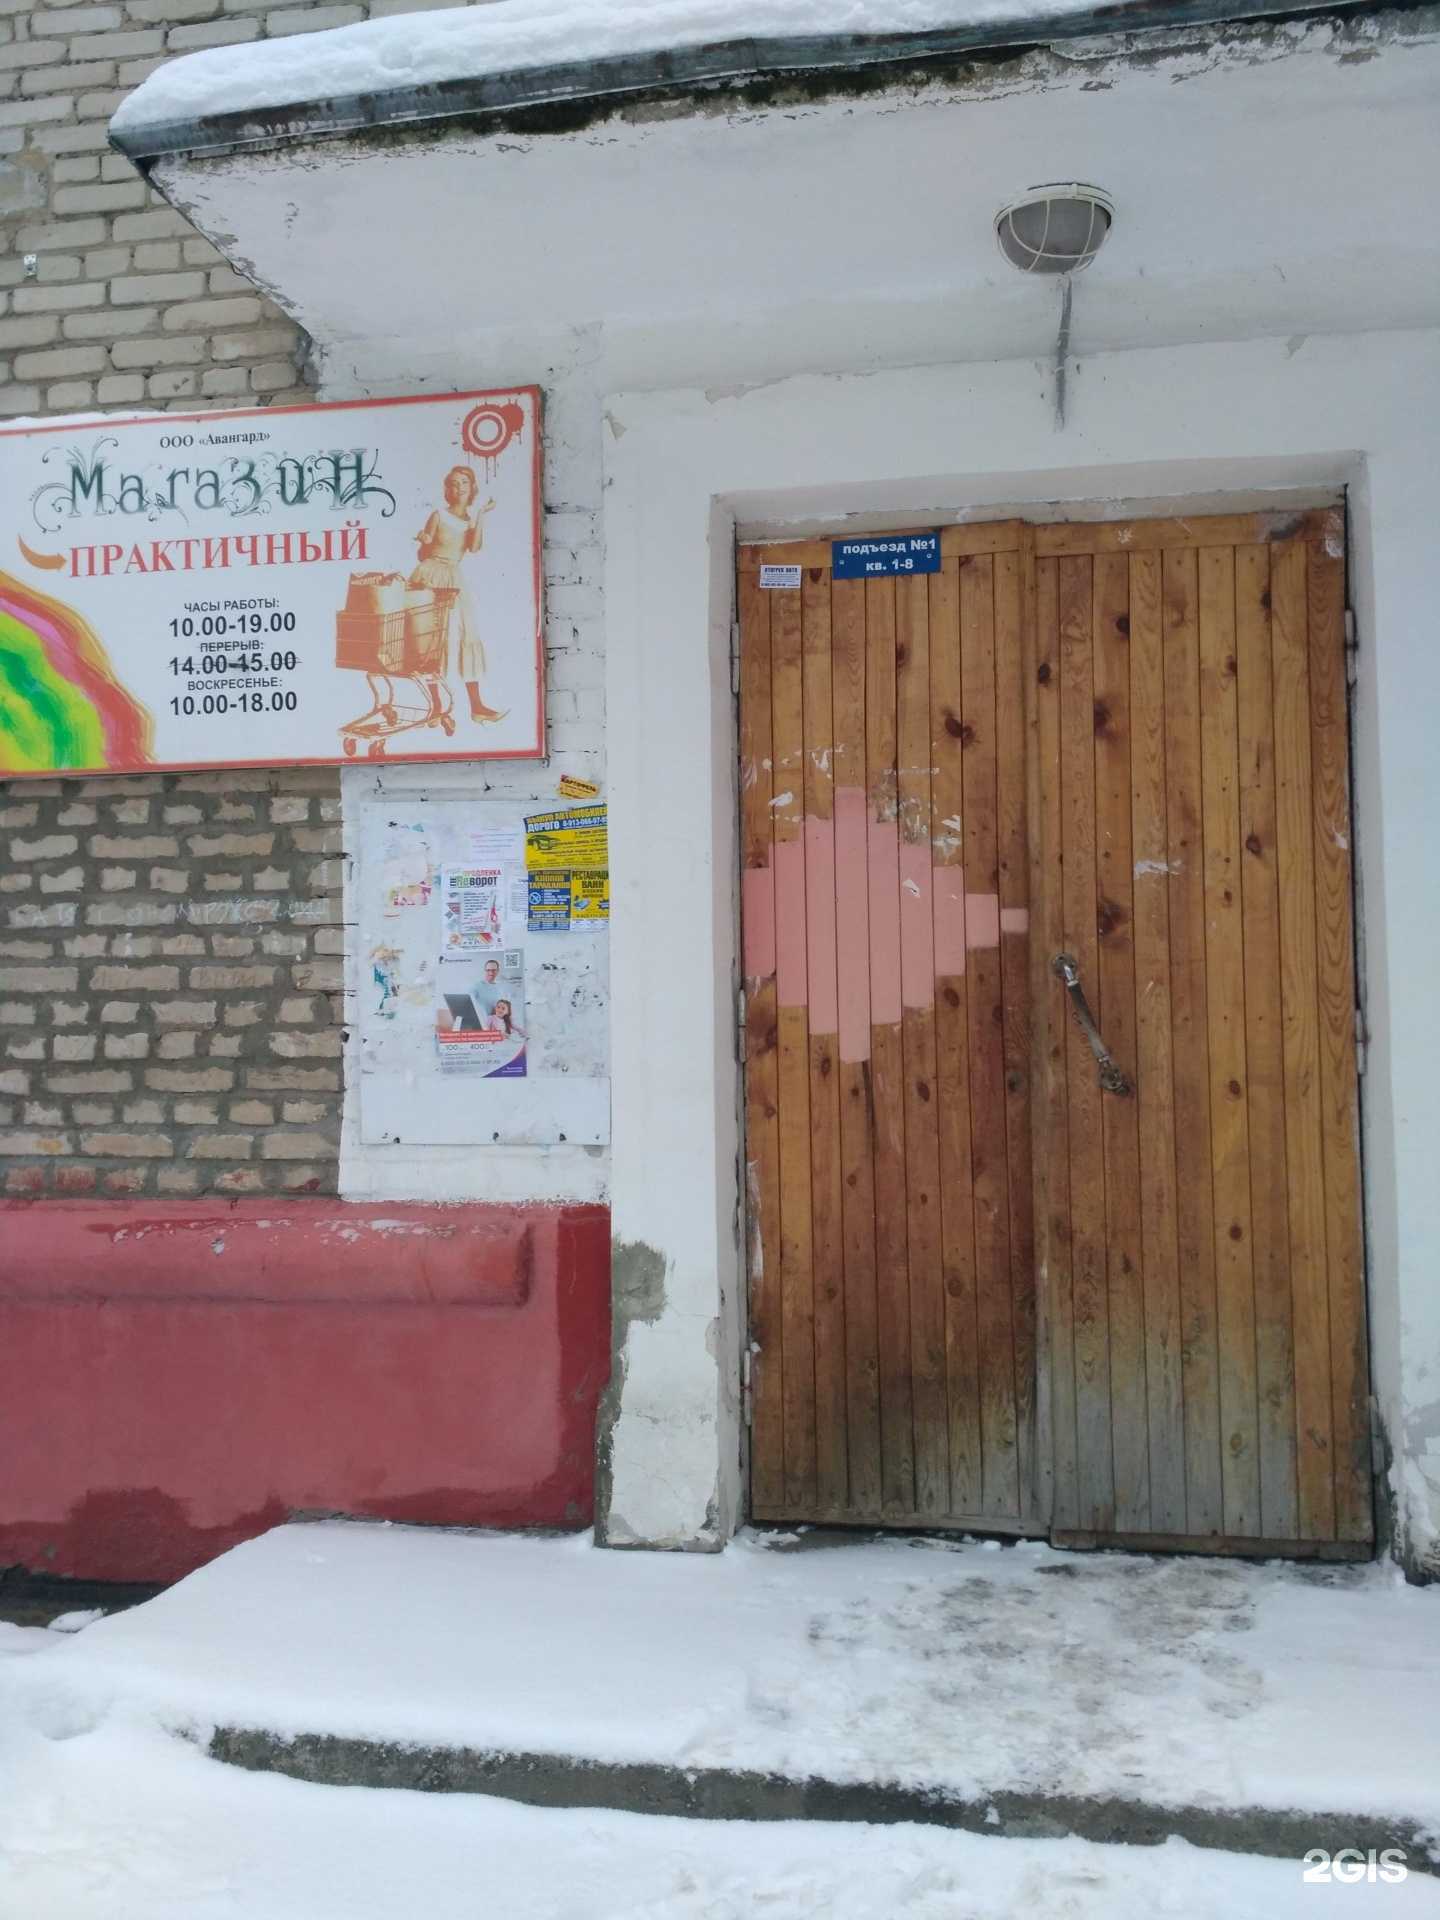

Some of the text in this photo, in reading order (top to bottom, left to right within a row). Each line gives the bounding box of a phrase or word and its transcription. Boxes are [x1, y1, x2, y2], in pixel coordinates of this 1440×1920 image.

[159, 431, 271, 449] ООО «Авангард»
[45, 445, 394, 520] Магазин
[69, 520, 369, 578] ПРАКТИЧНЫЙ
[842, 538, 936, 555] подъезд №1
[866, 558, 914, 571] кв. 1-8
[184, 598, 280, 612] ЧАСЫ РАБОТЫ:
[169, 611, 296, 637] 10.00-19.00
[200, 640, 265, 652] ПЕРЕРЫВ:
[169, 651, 297, 676] 14.00-15.00
[187, 677, 282, 691] ВОСКРЕСЕНЬЕ:
[170, 691, 297, 715] 10.00-18.00
